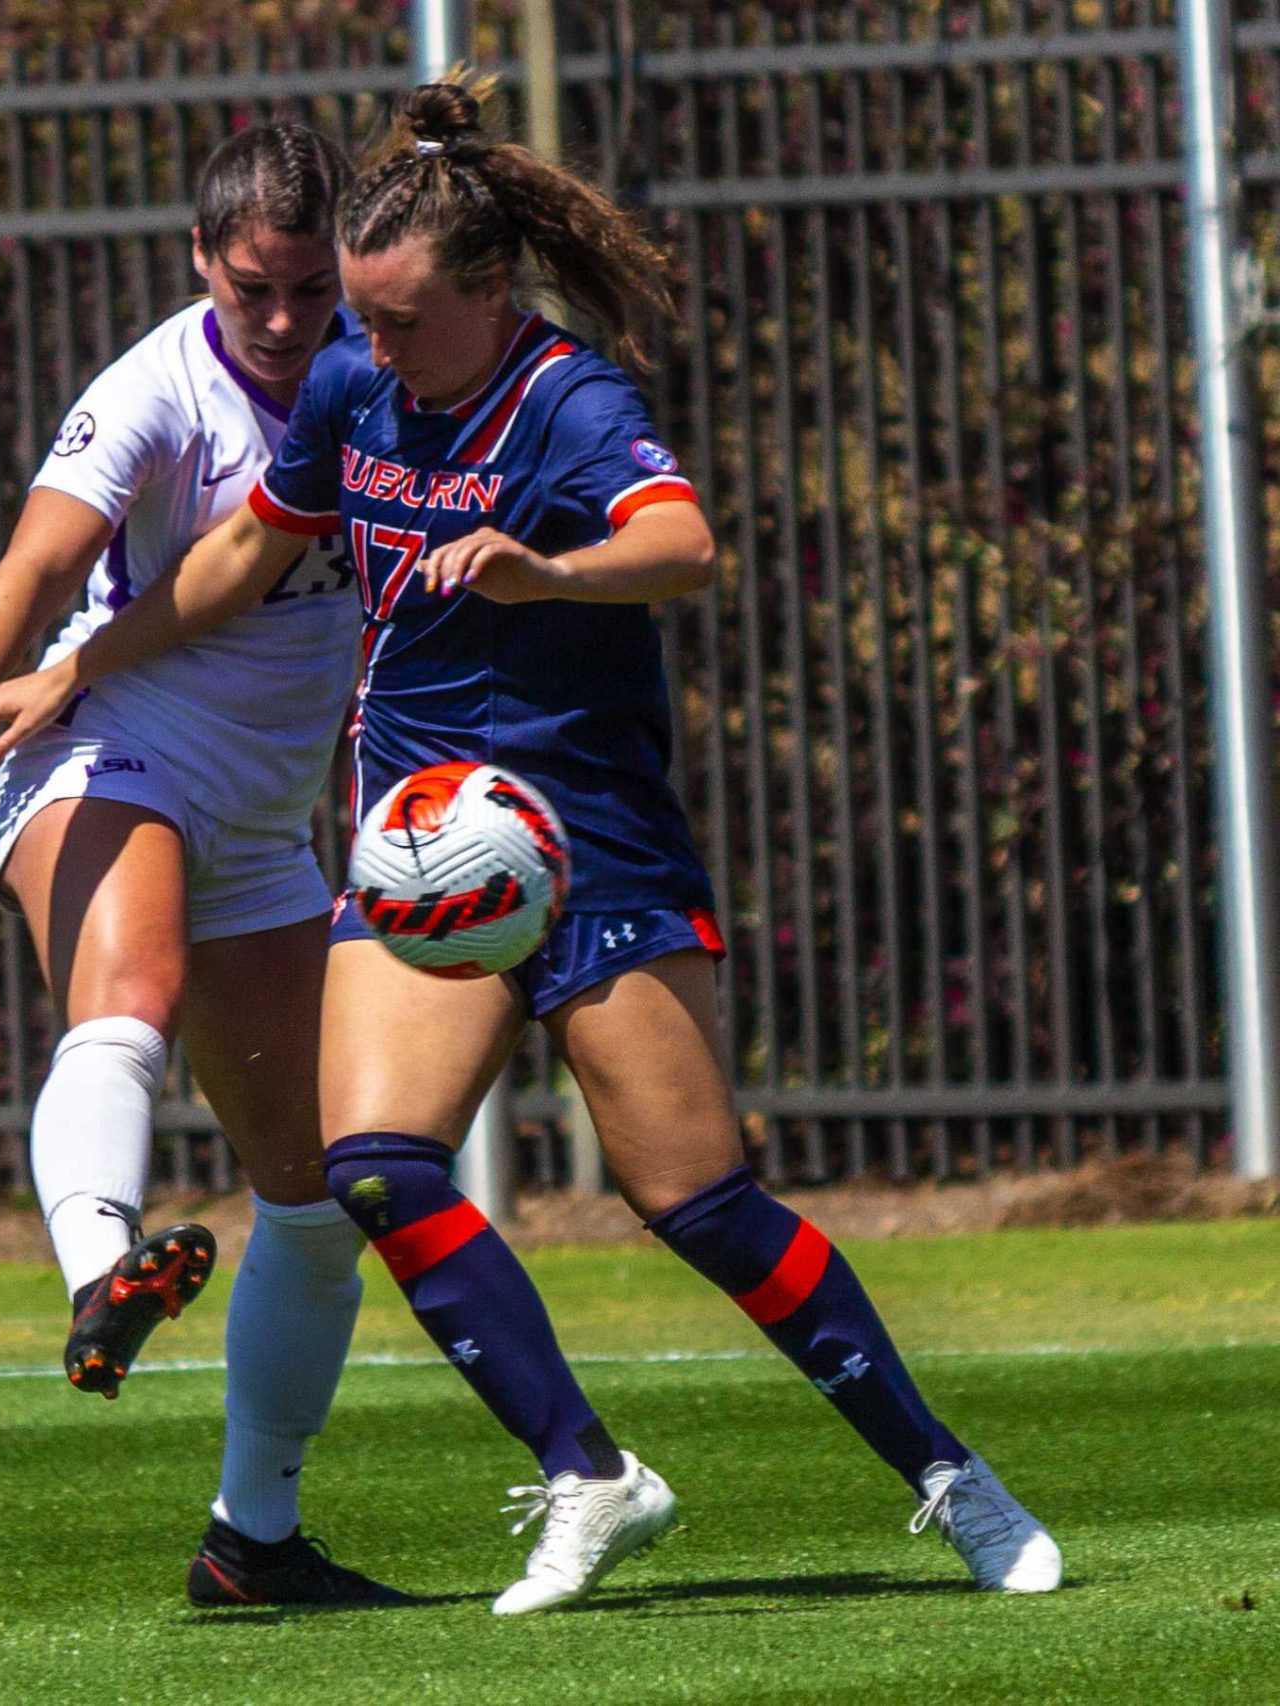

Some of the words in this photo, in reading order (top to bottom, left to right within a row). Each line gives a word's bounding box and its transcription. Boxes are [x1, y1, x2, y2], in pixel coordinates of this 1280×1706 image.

[341, 444, 504, 512] UBURN
[351, 518, 427, 621] 17
[85, 758, 146, 778] LSU
